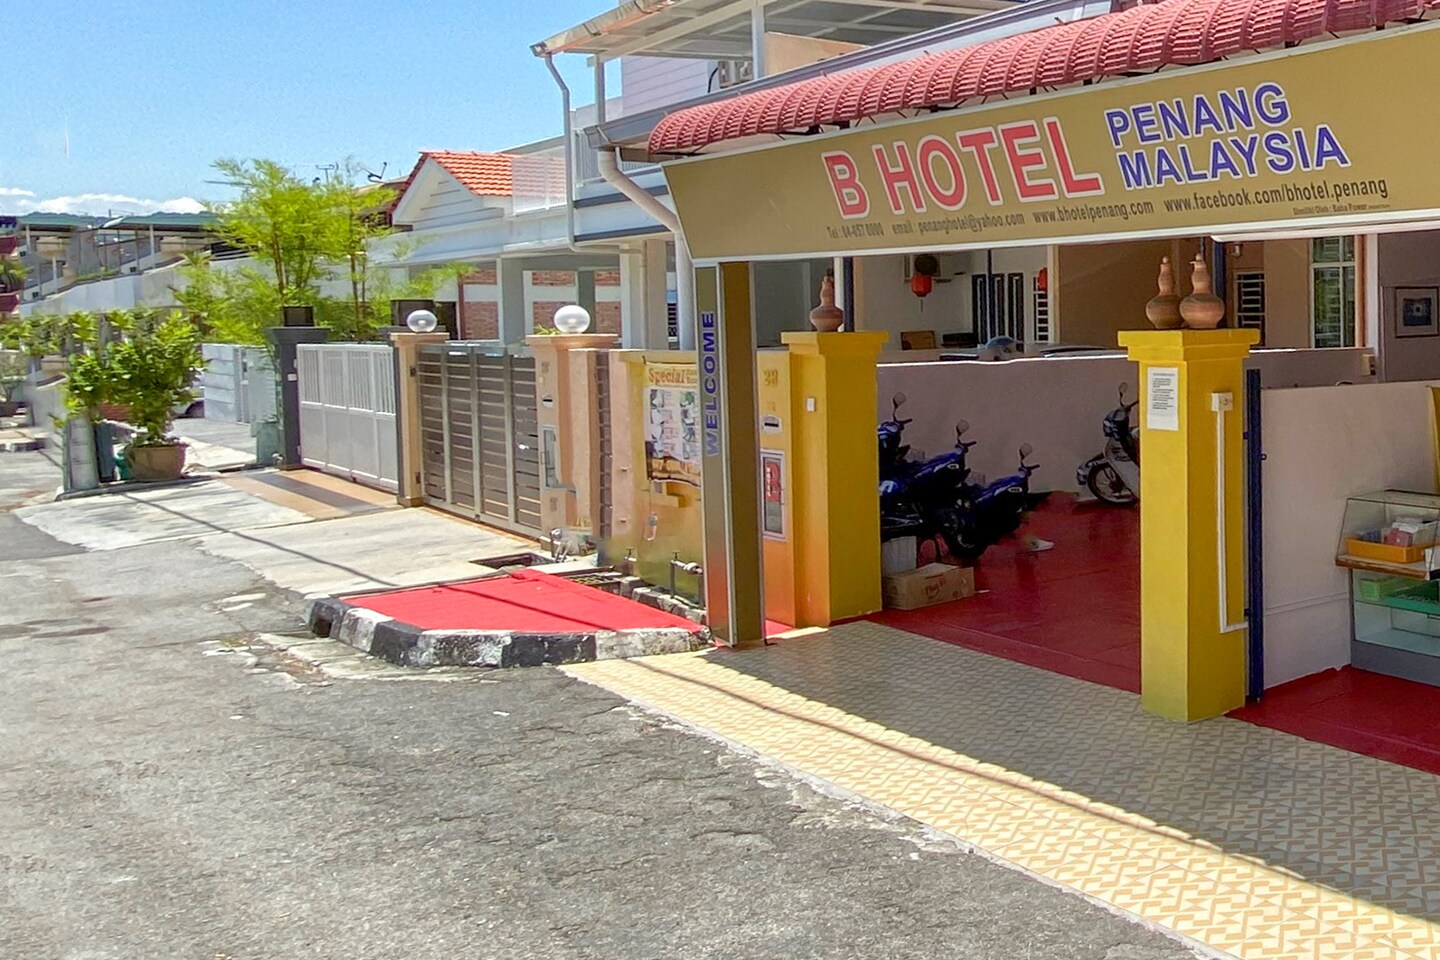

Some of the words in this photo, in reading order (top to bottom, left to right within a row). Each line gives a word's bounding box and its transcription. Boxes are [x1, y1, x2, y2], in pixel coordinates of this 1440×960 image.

[1105, 82, 1292, 148] PENANG
[819, 151, 870, 219] B
[872, 117, 1104, 216] HOTEL
[1117, 124, 1352, 190] MALAYSIA
[1032, 201, 1154, 225] www.bhotelpenang.com
[1164, 177, 1388, 212] www.facebook.com/bhotel.penang
[648, 367, 685, 385] Special
[701, 311, 719, 457] WELCOME
